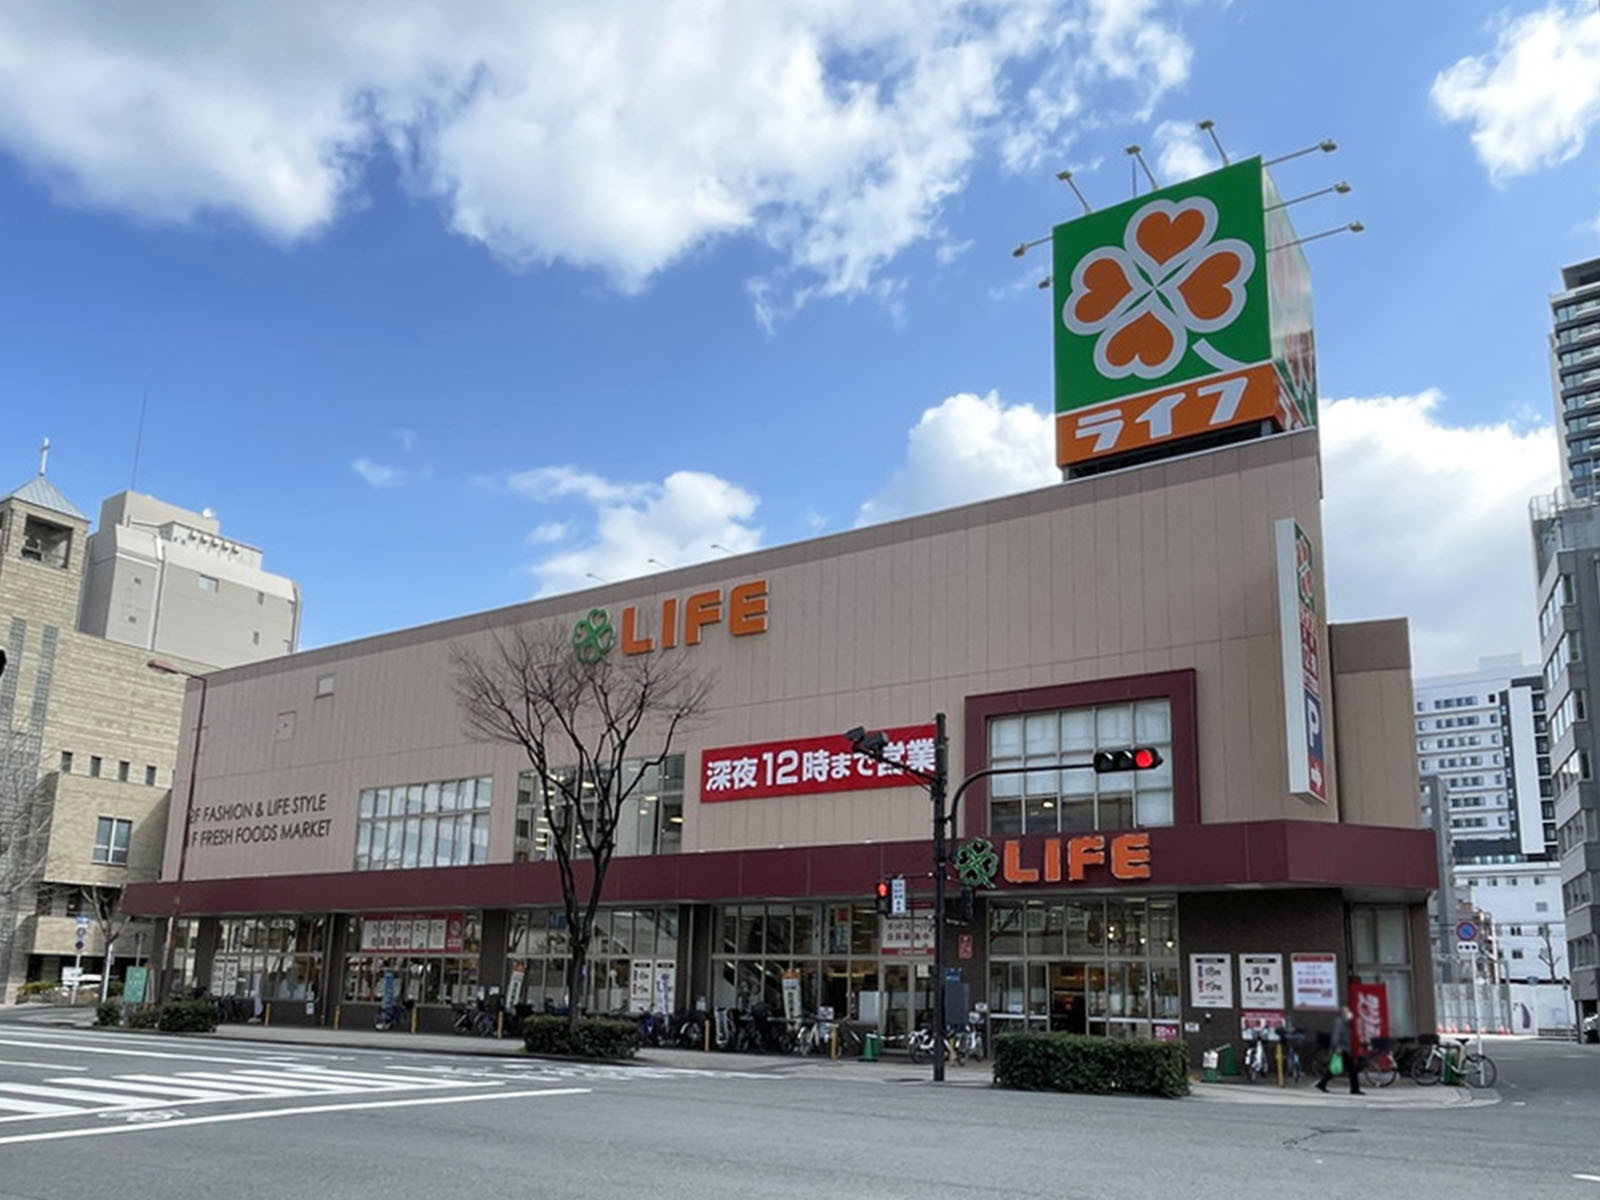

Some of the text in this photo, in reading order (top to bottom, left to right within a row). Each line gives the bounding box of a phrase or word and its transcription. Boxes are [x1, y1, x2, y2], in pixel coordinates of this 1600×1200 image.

[1075, 376, 1248, 452] ライフ
[621, 580, 767, 656] LIFE
[1307, 698, 1320, 747] P
[706, 738, 935, 791] 深夜12時まで営業
[200, 828, 234, 846] FRESH
[235, 824, 278, 844] FOODS
[280, 819, 332, 840] MARKET
[203, 802, 253, 821] FASHION
[255, 801, 263, 818] &
[1004, 833, 1149, 882] LIFE
